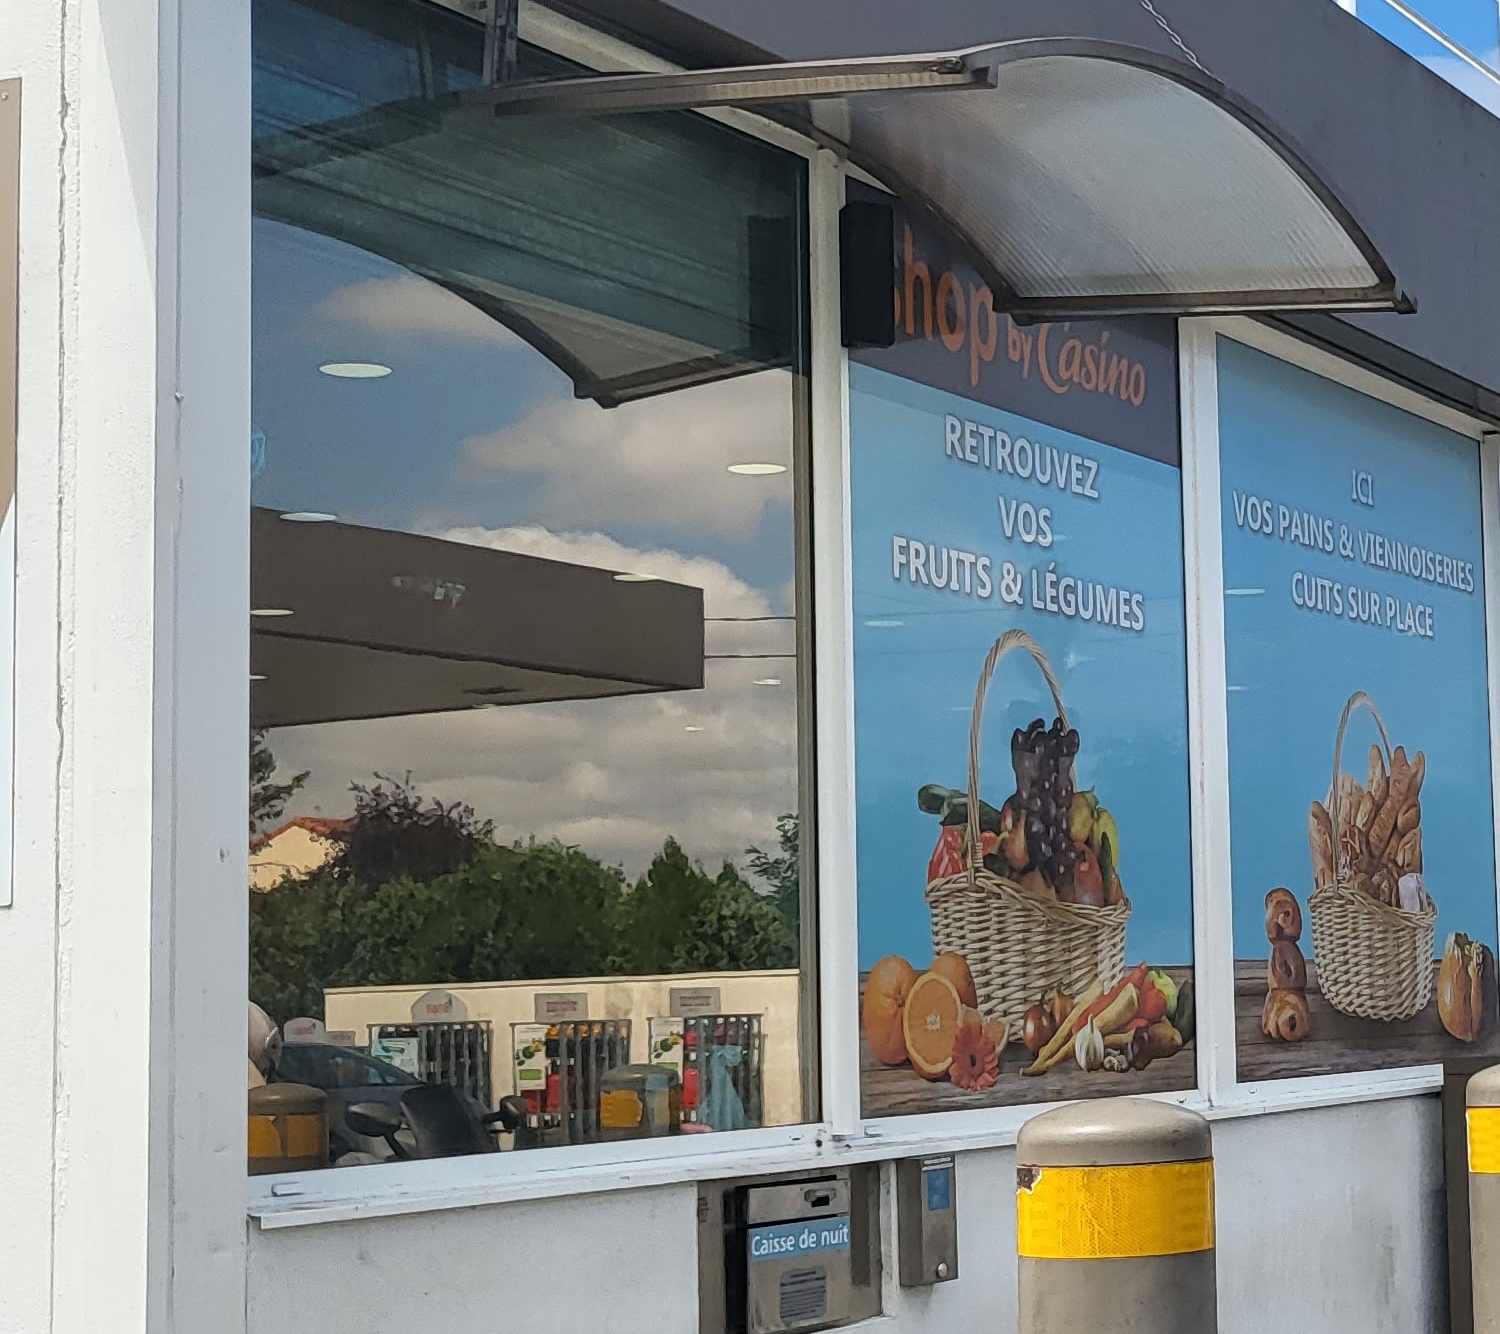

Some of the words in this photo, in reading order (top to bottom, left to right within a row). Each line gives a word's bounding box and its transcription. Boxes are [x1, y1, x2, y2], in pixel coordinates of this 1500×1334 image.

[895, 224, 997, 388] hop
[1007, 319, 1033, 379] by
[1037, 322, 1146, 407] Casino
[944, 414, 1099, 499] RETROUVEZ
[1351, 469, 1374, 506] ICI
[999, 496, 1053, 548] VOS
[1232, 490, 1273, 534] VOS
[1278, 505, 1334, 552] PAINS
[1339, 524, 1355, 559] &
[1358, 530, 1474, 593] VIENNOISERIES
[892, 536, 992, 598] FRUITS
[1000, 562, 1024, 605] &
[1032, 562, 1144, 631] LÉGUMES
[1292, 572, 1343, 615] CUITS
[1348, 586, 1382, 626] SUR
[1386, 597, 1434, 637] PLACE
[752, 1233, 796, 1256] Caisse
[798, 1227, 817, 1249] de
[821, 1223, 849, 1246] nuit
